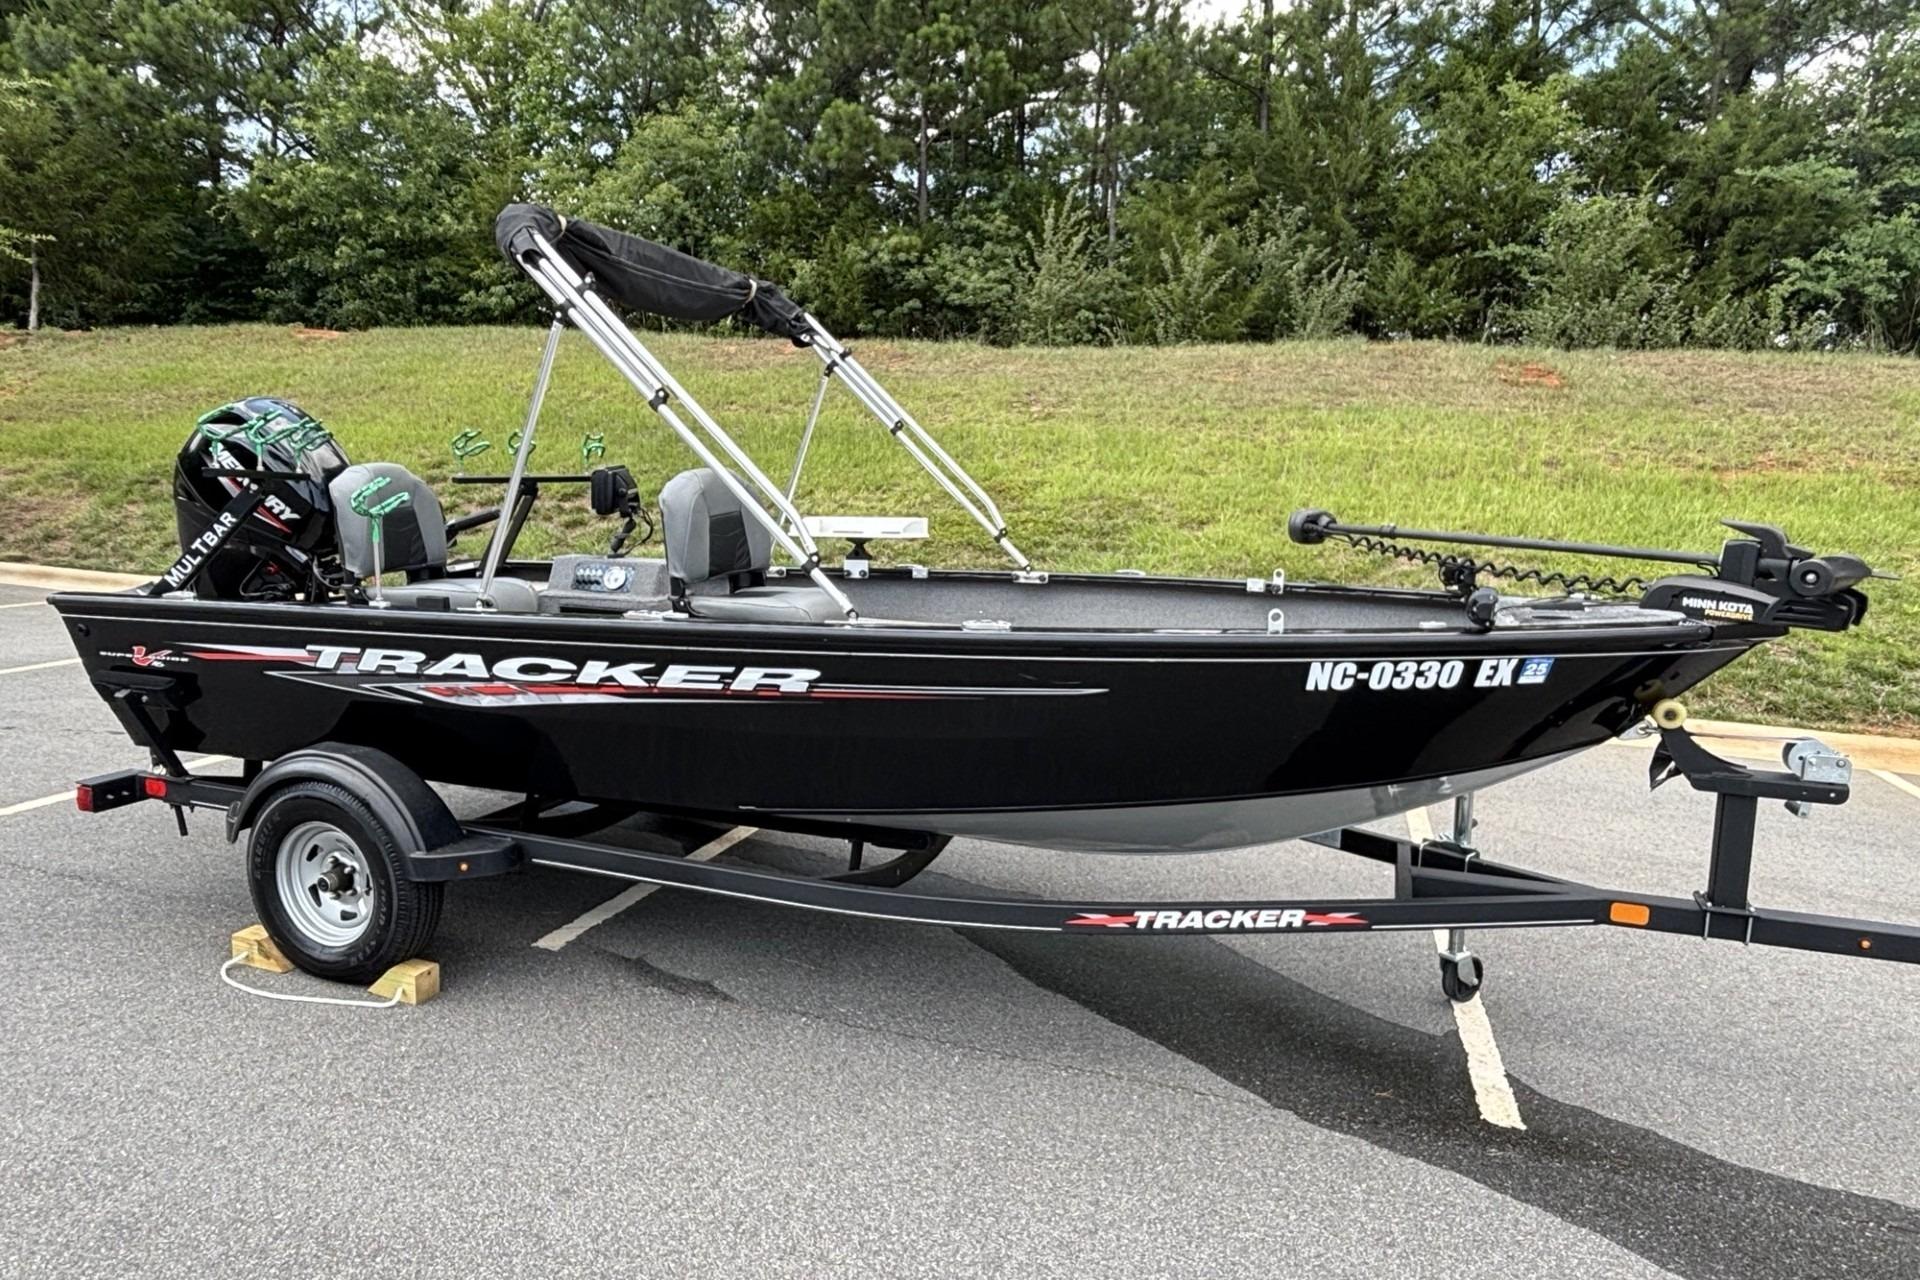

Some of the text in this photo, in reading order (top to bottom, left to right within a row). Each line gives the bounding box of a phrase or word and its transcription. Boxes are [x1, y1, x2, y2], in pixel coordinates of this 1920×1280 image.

[208, 442, 301, 519] MERY
[163, 511, 237, 588] MULTBAR
[1682, 596, 1754, 614] MINN KOTA
[305, 644, 822, 693] TRACKER
[1305, 658, 1519, 691] NC-0330 EX
[1523, 663, 1549, 676] 25
[1133, 908, 1307, 929] TRACKER
